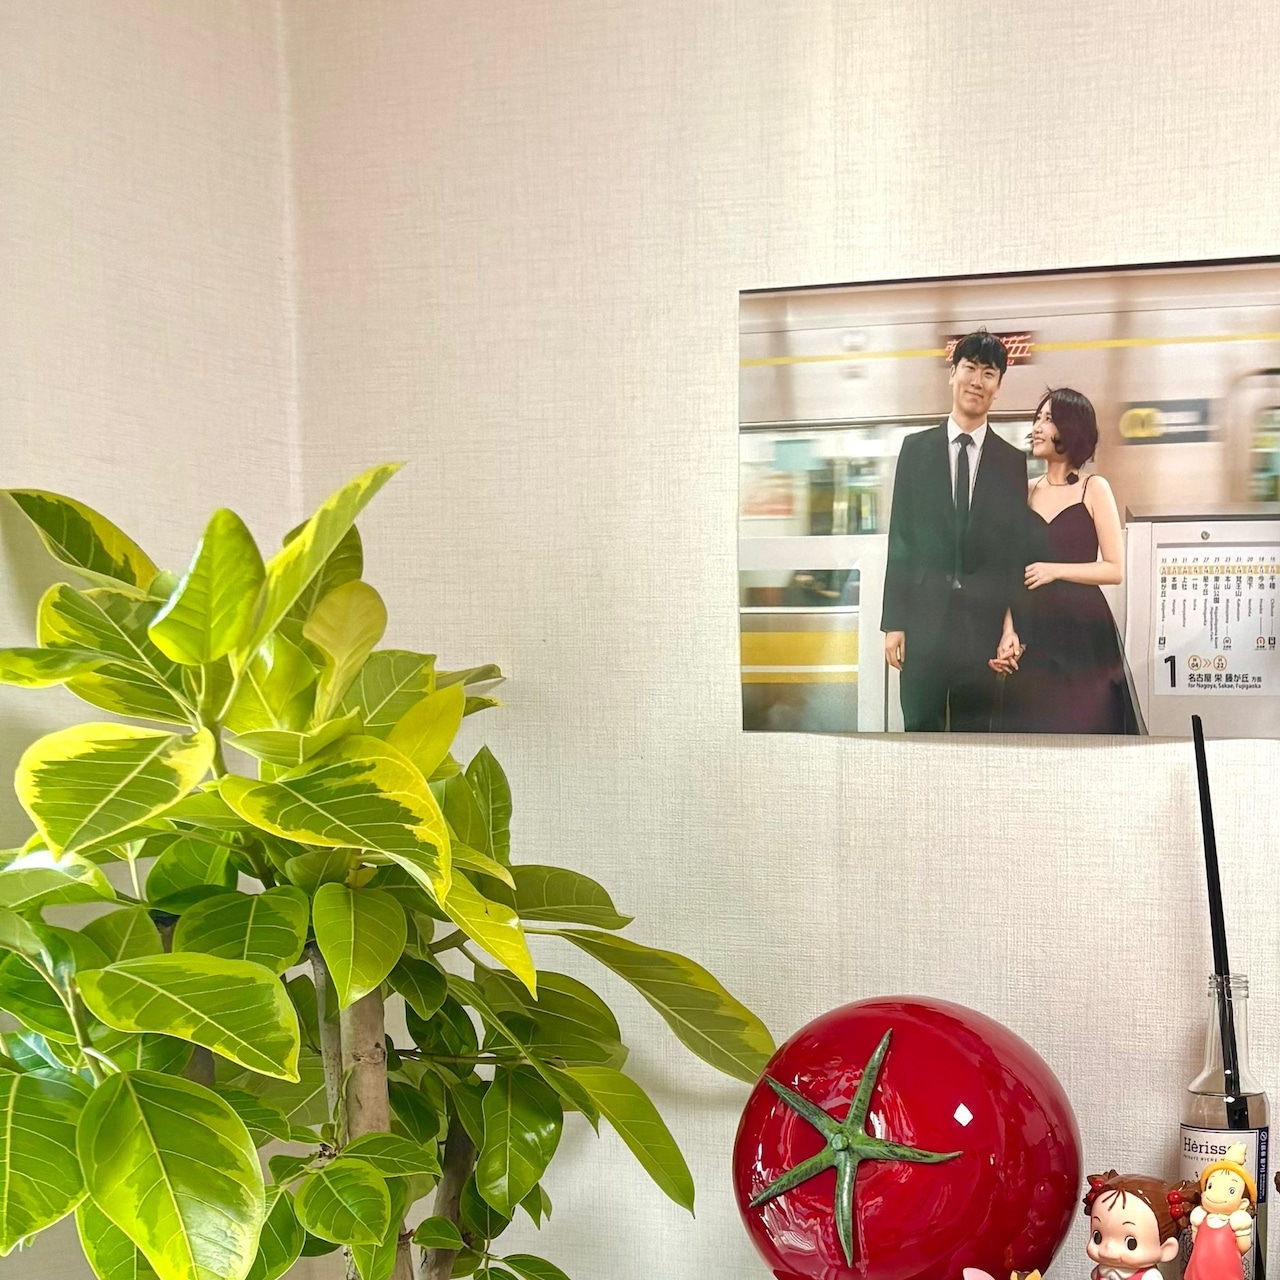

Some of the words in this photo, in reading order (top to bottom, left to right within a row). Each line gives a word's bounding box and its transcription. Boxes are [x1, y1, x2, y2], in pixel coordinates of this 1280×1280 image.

[1164, 655, 1176, 687] 1
[1188, 674, 1211, 683] 名古屋
[1215, 674, 1222, 683] 栄
